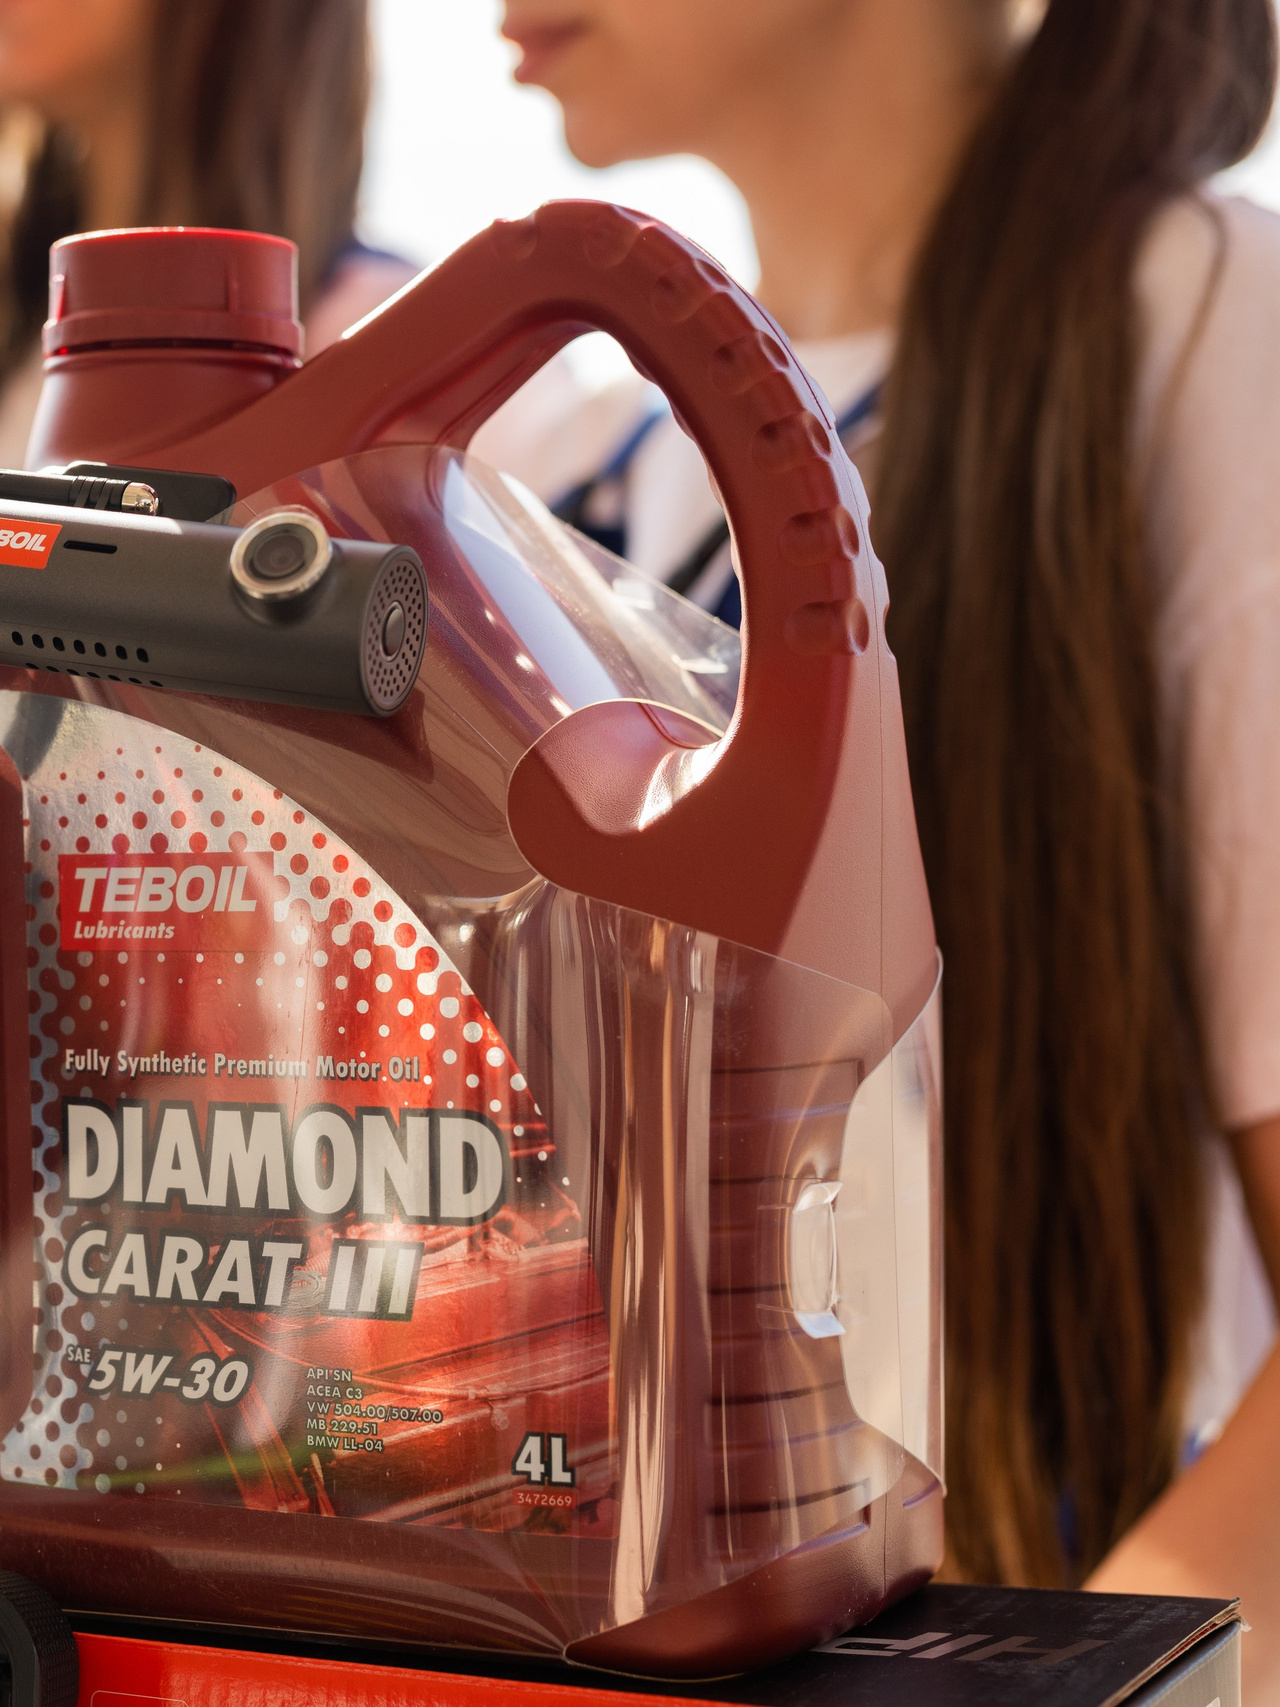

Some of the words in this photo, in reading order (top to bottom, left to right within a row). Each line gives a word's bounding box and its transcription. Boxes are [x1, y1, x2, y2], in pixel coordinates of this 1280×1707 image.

[73, 865, 257, 914] TEBOIL
[73, 919, 176, 940] Lubricants
[64, 1048, 110, 1077] Fully
[117, 1049, 207, 1078] Synthetic
[213, 1052, 308, 1080] Premium
[315, 1054, 382, 1081] Motor
[387, 1055, 421, 1082] Oil
[63, 1099, 508, 1222] DIAMOND
[64, 1225, 304, 1307] CARAT
[326, 1240, 423, 1318] III
[66, 1345, 92, 1363] SAE
[86, 1349, 251, 1403] 5W-30
[306, 1367, 330, 1381] API
[332, 1368, 353, 1382] SN
[306, 1385, 342, 1398] ACEA
[345, 1387, 364, 1400] C3
[306, 1402, 330, 1415] VW
[334, 1403, 444, 1424] 504.00/507.00
[306, 1418, 327, 1431] MB
[330, 1420, 379, 1436] 229.51
[306, 1435, 340, 1449] BMW
[342, 1437, 384, 1452] LL-04
[513, 1433, 574, 1486] 4L
[516, 1492, 573, 1507] 3472669
